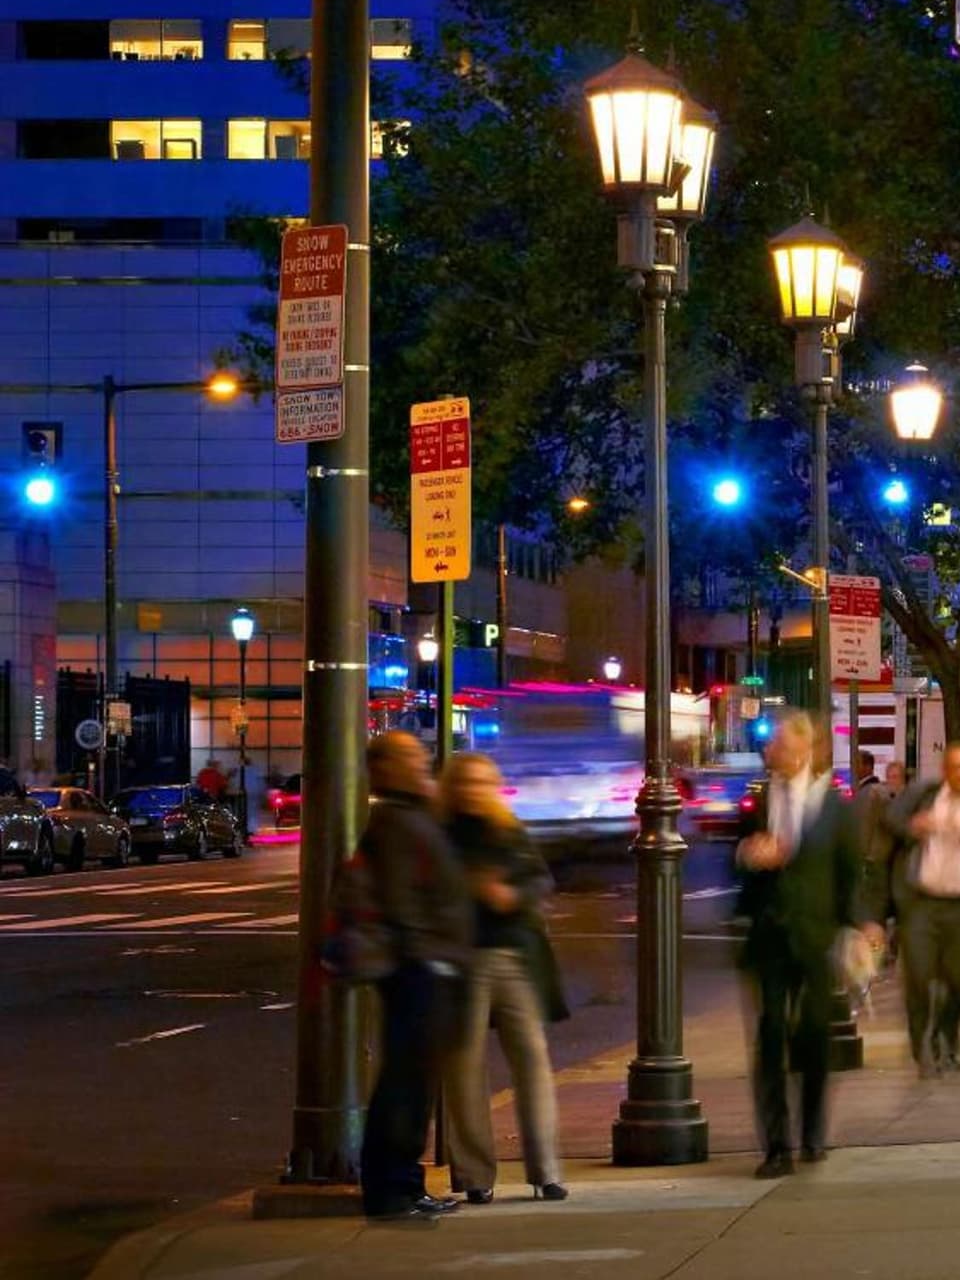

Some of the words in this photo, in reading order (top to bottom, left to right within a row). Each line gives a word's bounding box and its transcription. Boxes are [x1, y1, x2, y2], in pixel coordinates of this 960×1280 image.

[296, 234, 329, 252] SNOW
[284, 254, 343, 274] EMERGENCY
[293, 274, 329, 292] ROUTE
[485, 624, 499, 647] P
